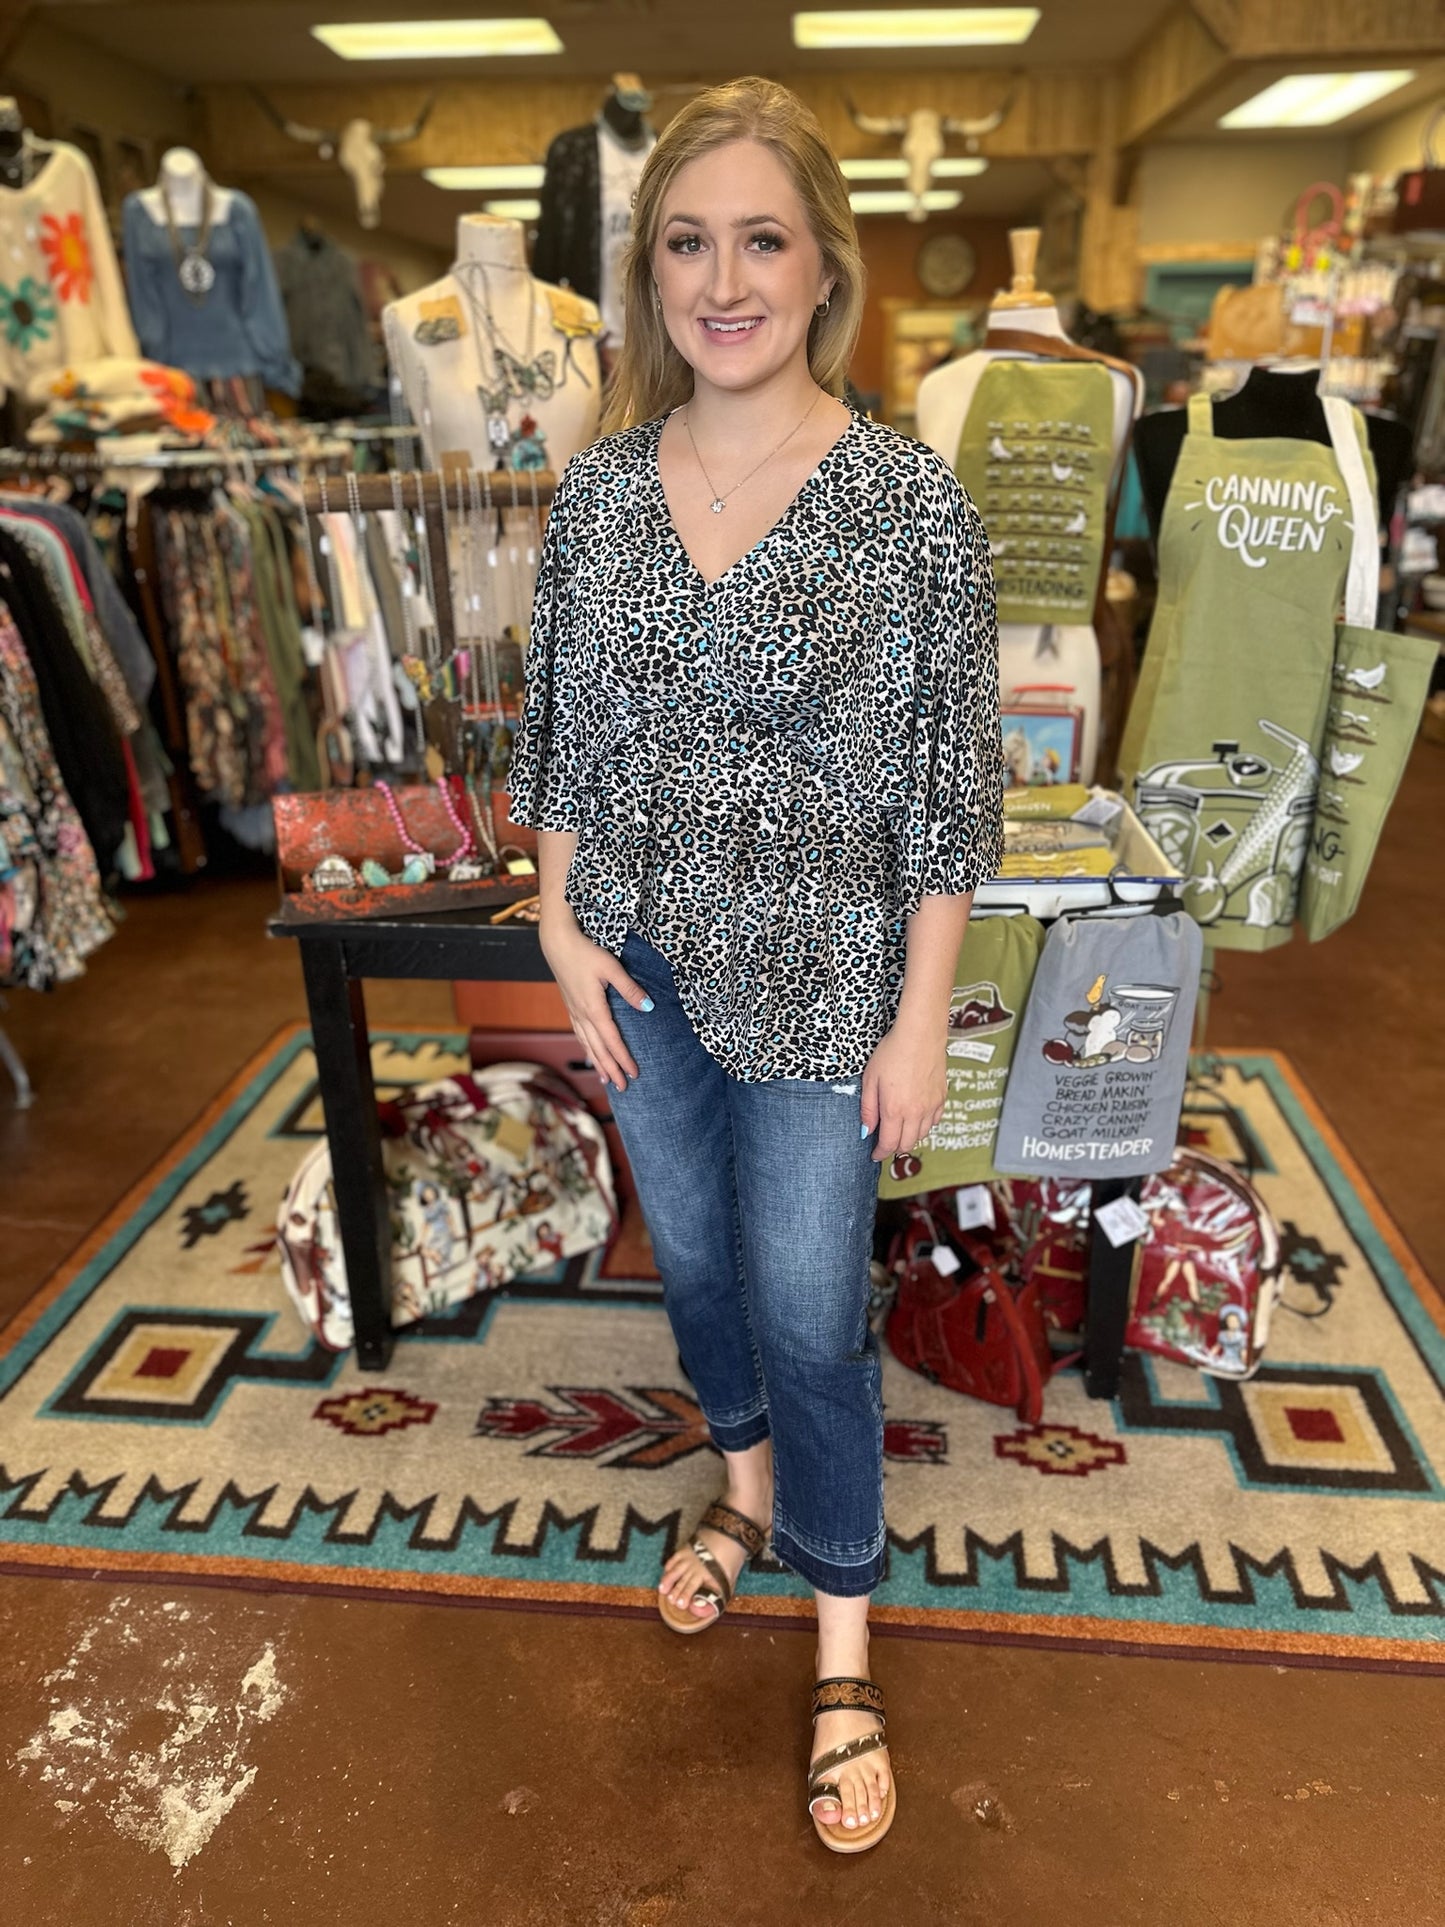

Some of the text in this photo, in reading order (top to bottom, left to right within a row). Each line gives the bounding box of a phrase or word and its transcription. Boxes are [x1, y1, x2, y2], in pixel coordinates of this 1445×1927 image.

[1205, 474, 1343, 524] CANNING
[1217, 503, 1325, 568] QUEEN
[1118, 1000, 1140, 1010] GOAT
[1055, 1073, 1099, 1088] VEGGIE
[1055, 1087, 1097, 1101] BREAD
[1046, 1100, 1109, 1113] CHICKEN
[1041, 1113, 1094, 1126] CRAZY
[1041, 1126, 1088, 1140] GOAT
[1022, 1135, 1154, 1160] HOMESTEADER
